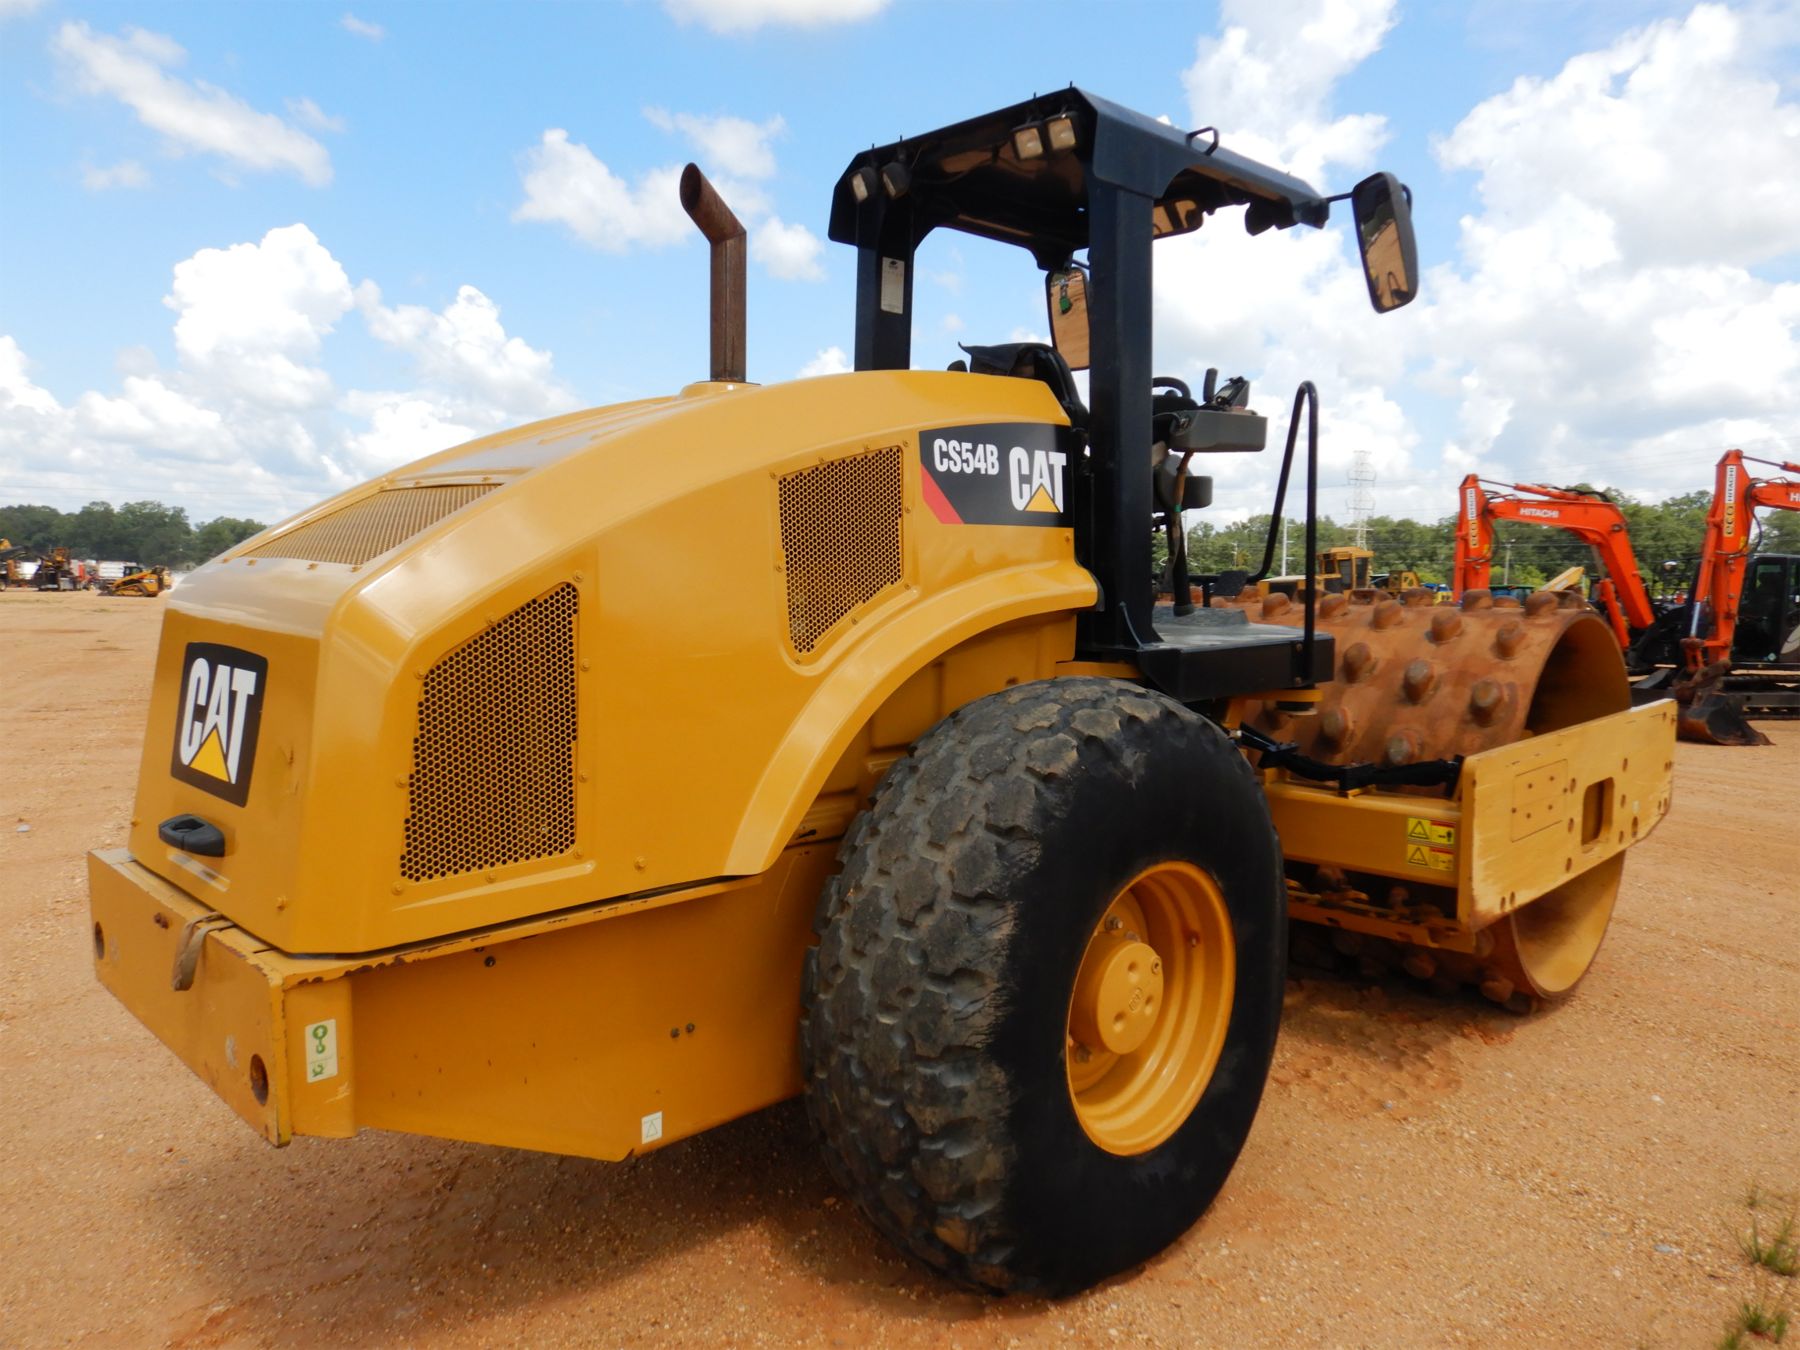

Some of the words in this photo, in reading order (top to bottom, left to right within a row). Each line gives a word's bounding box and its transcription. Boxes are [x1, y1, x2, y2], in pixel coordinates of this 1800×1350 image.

[933, 438, 1000, 475] CS54B
[1009, 446, 1067, 513] CAT
[1726, 466, 1735, 502] HITACHI
[1520, 507, 1559, 518] HITACHI
[180, 657, 257, 785] CAT
